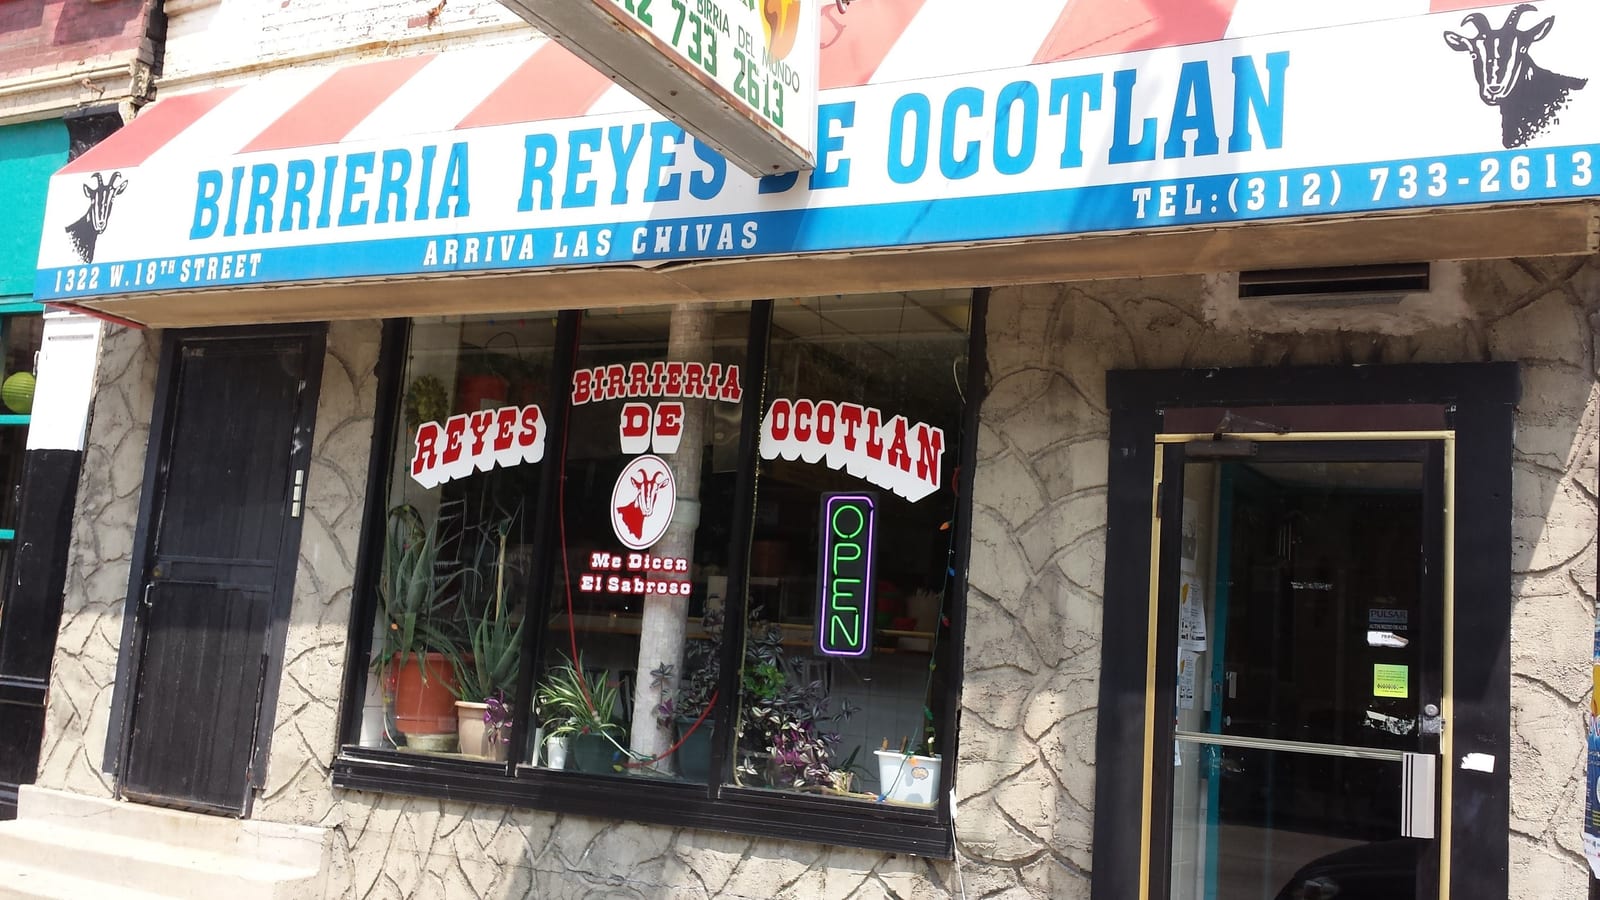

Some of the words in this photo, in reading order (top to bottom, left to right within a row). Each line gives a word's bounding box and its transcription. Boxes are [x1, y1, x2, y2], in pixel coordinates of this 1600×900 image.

[697, 0, 730, 37] BIRRIA
[738, 25, 755, 58] DEL
[762, 46, 800, 93] MUNDO
[733, 48, 784, 128] 2613
[189, 141, 469, 240] BIRRIERIA
[517, 121, 727, 212] REYES
[887, 50, 1290, 184] OCOTLAN
[1369, 152, 1592, 202] 733-2613
[423, 234, 534, 266] ARRIVA
[553, 229, 612, 258] LAS
[631, 221, 760, 254] CHIVAS
[54, 266, 100, 293] 1322
[179, 253, 262, 283] STREET
[572, 362, 743, 405] BIRRIERIA
[410, 404, 545, 483] REYES
[621, 404, 684, 446] DE
[764, 399, 945, 495] OCOTLAN
[580, 575, 602, 592] El
[606, 576, 692, 596] Sabroso
[590, 551, 622, 570] Me
[627, 552, 688, 572] Dicen
[832, 504, 865, 647] OPEN
